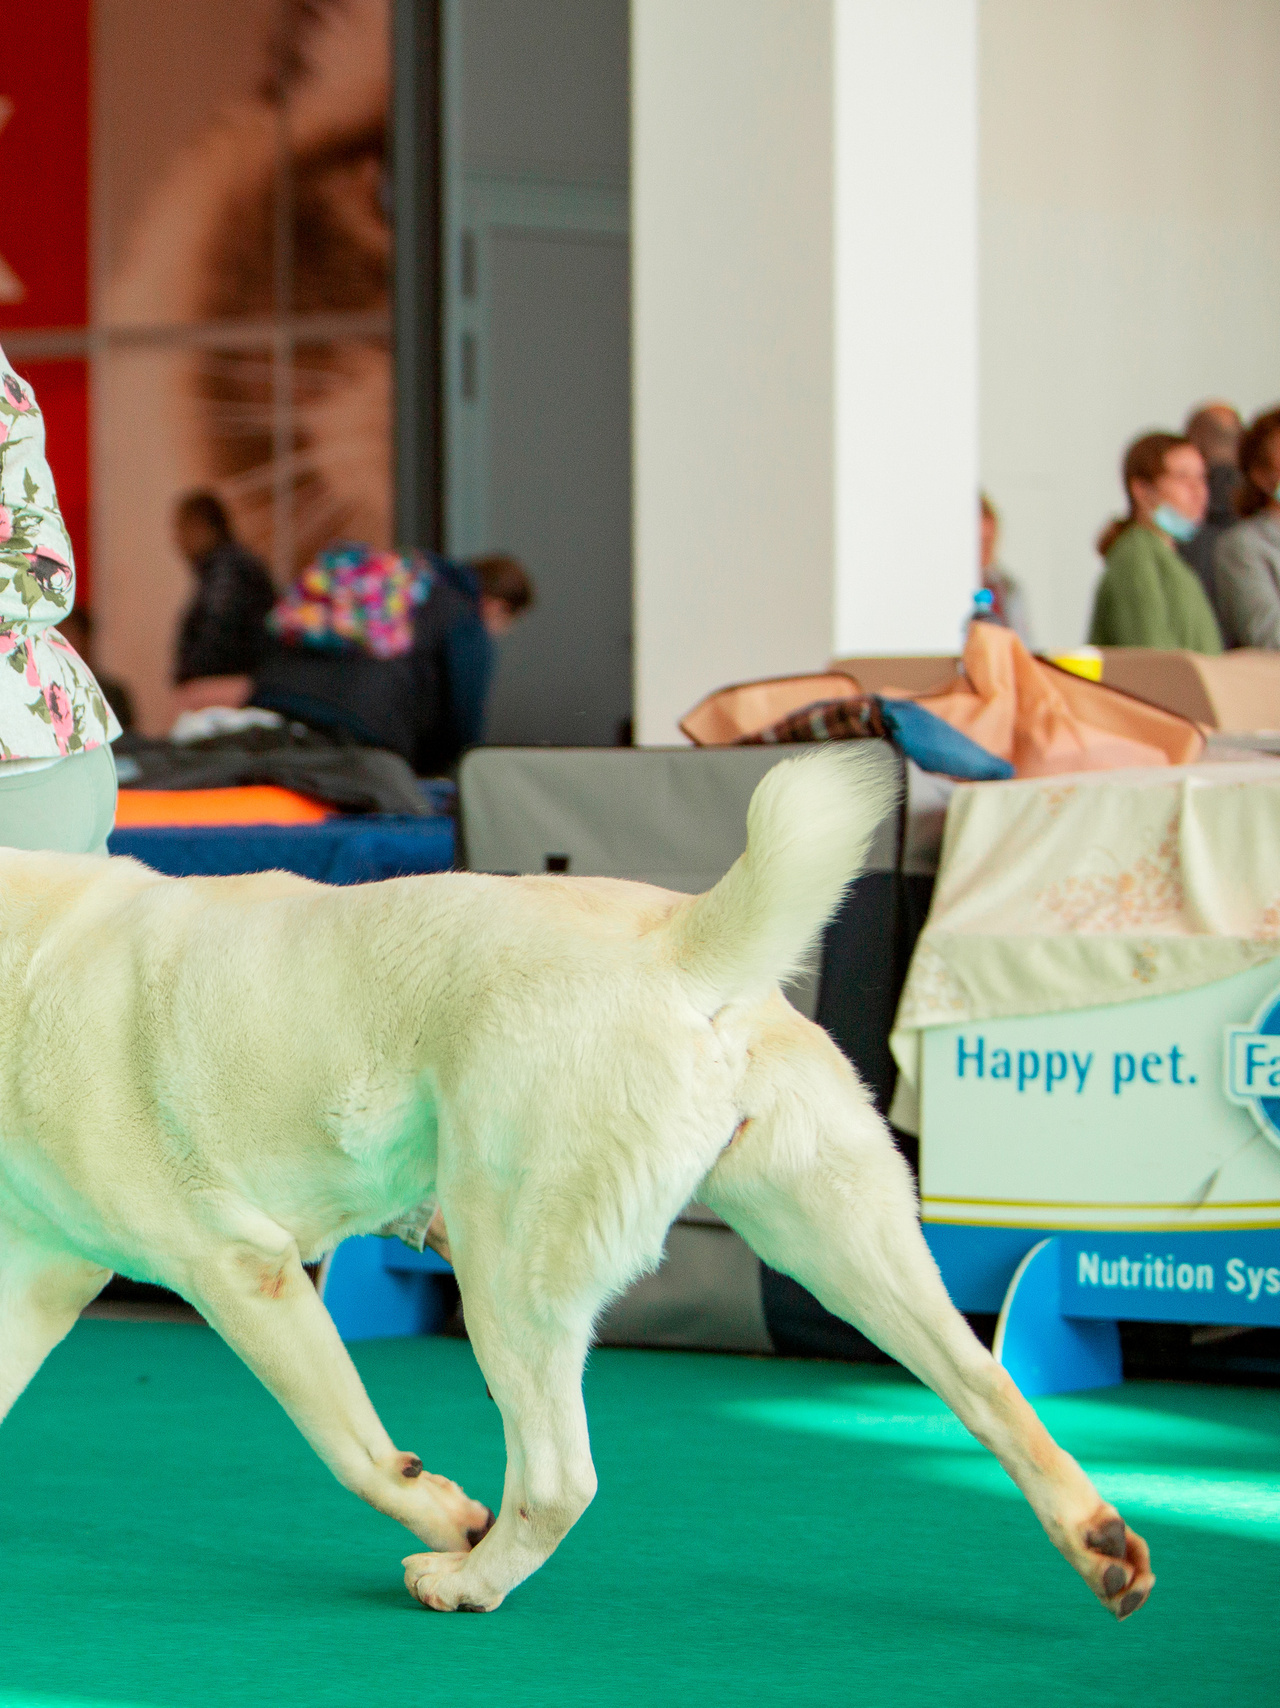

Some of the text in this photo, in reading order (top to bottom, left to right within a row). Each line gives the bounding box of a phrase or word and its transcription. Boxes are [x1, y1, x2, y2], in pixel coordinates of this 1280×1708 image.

[956, 1036, 1198, 1095] Happy pet.
[1077, 1252, 1214, 1292] Nutrition
